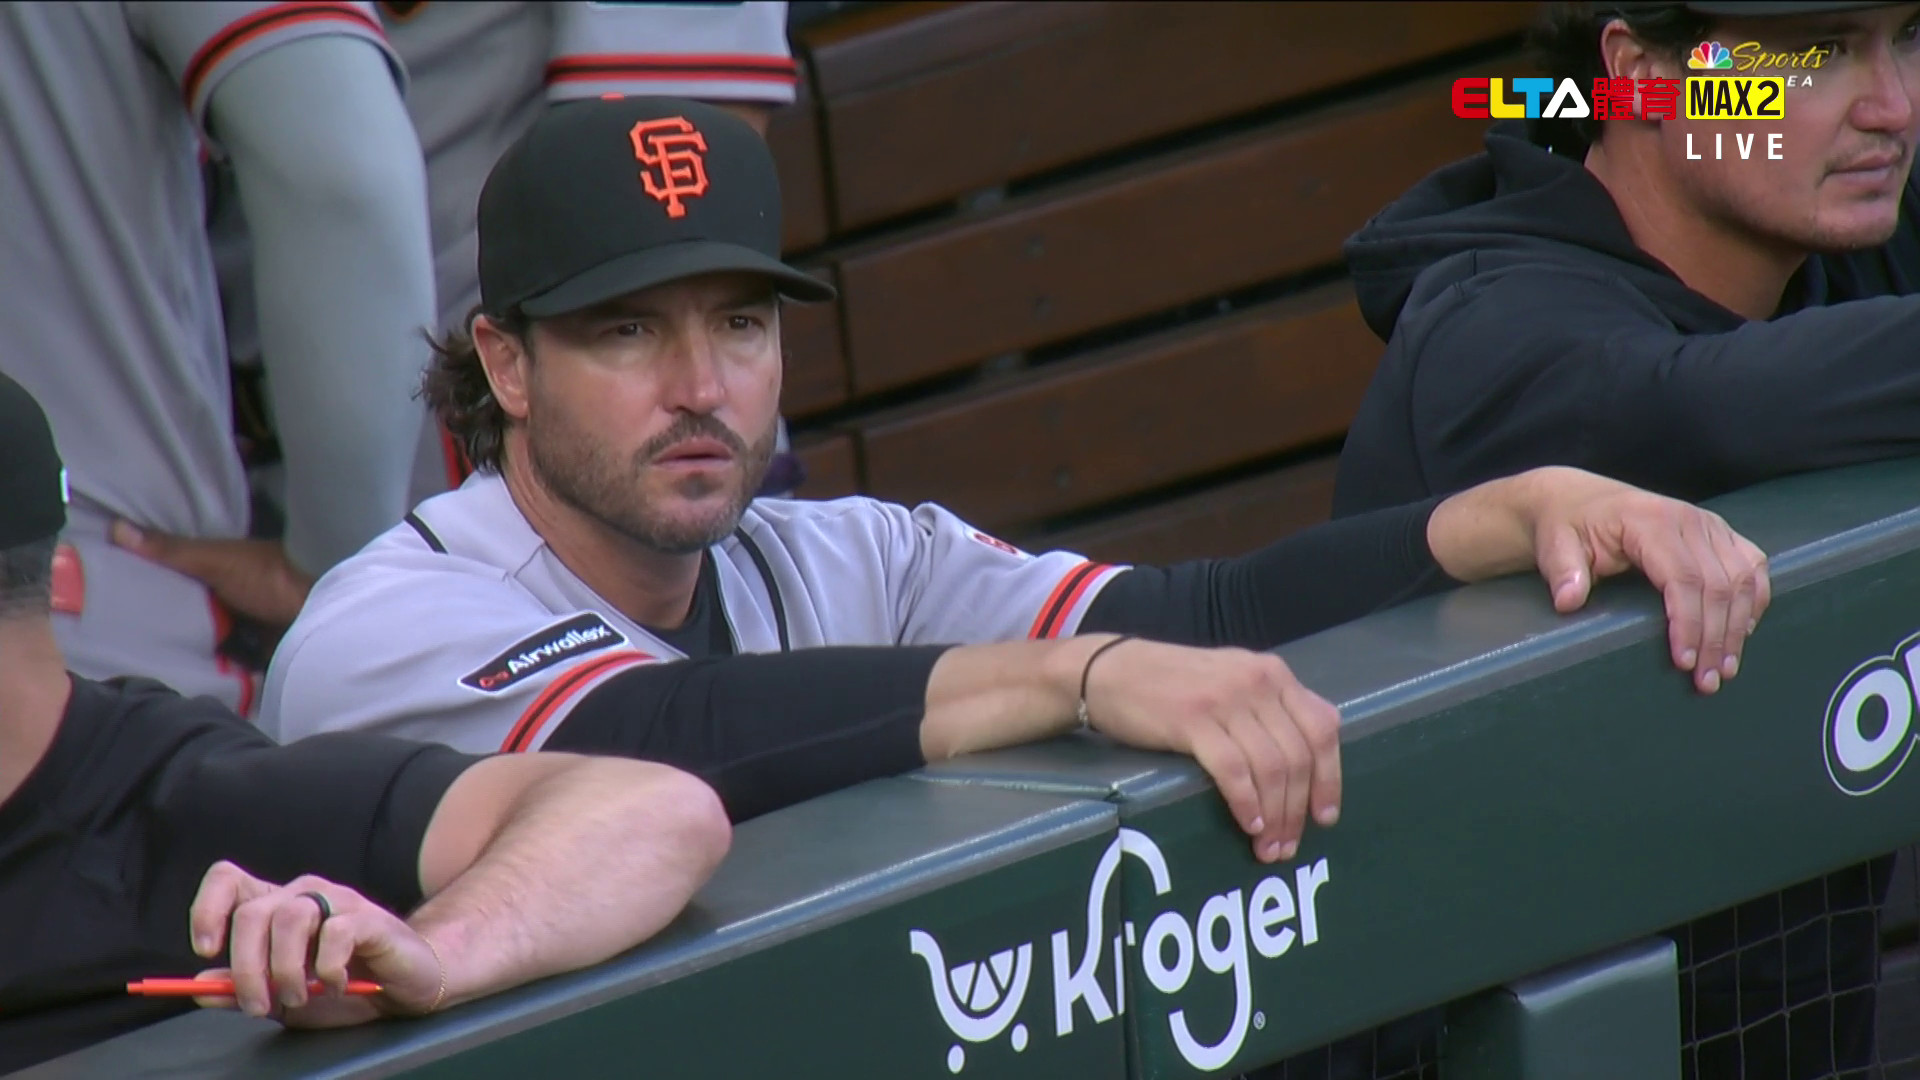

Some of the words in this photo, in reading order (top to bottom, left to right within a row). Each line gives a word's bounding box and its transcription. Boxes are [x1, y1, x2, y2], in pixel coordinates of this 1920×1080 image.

[629, 115, 709, 218] SF
[507, 624, 613, 675] Airwallex
[1051, 827, 1330, 1071] Kroger
